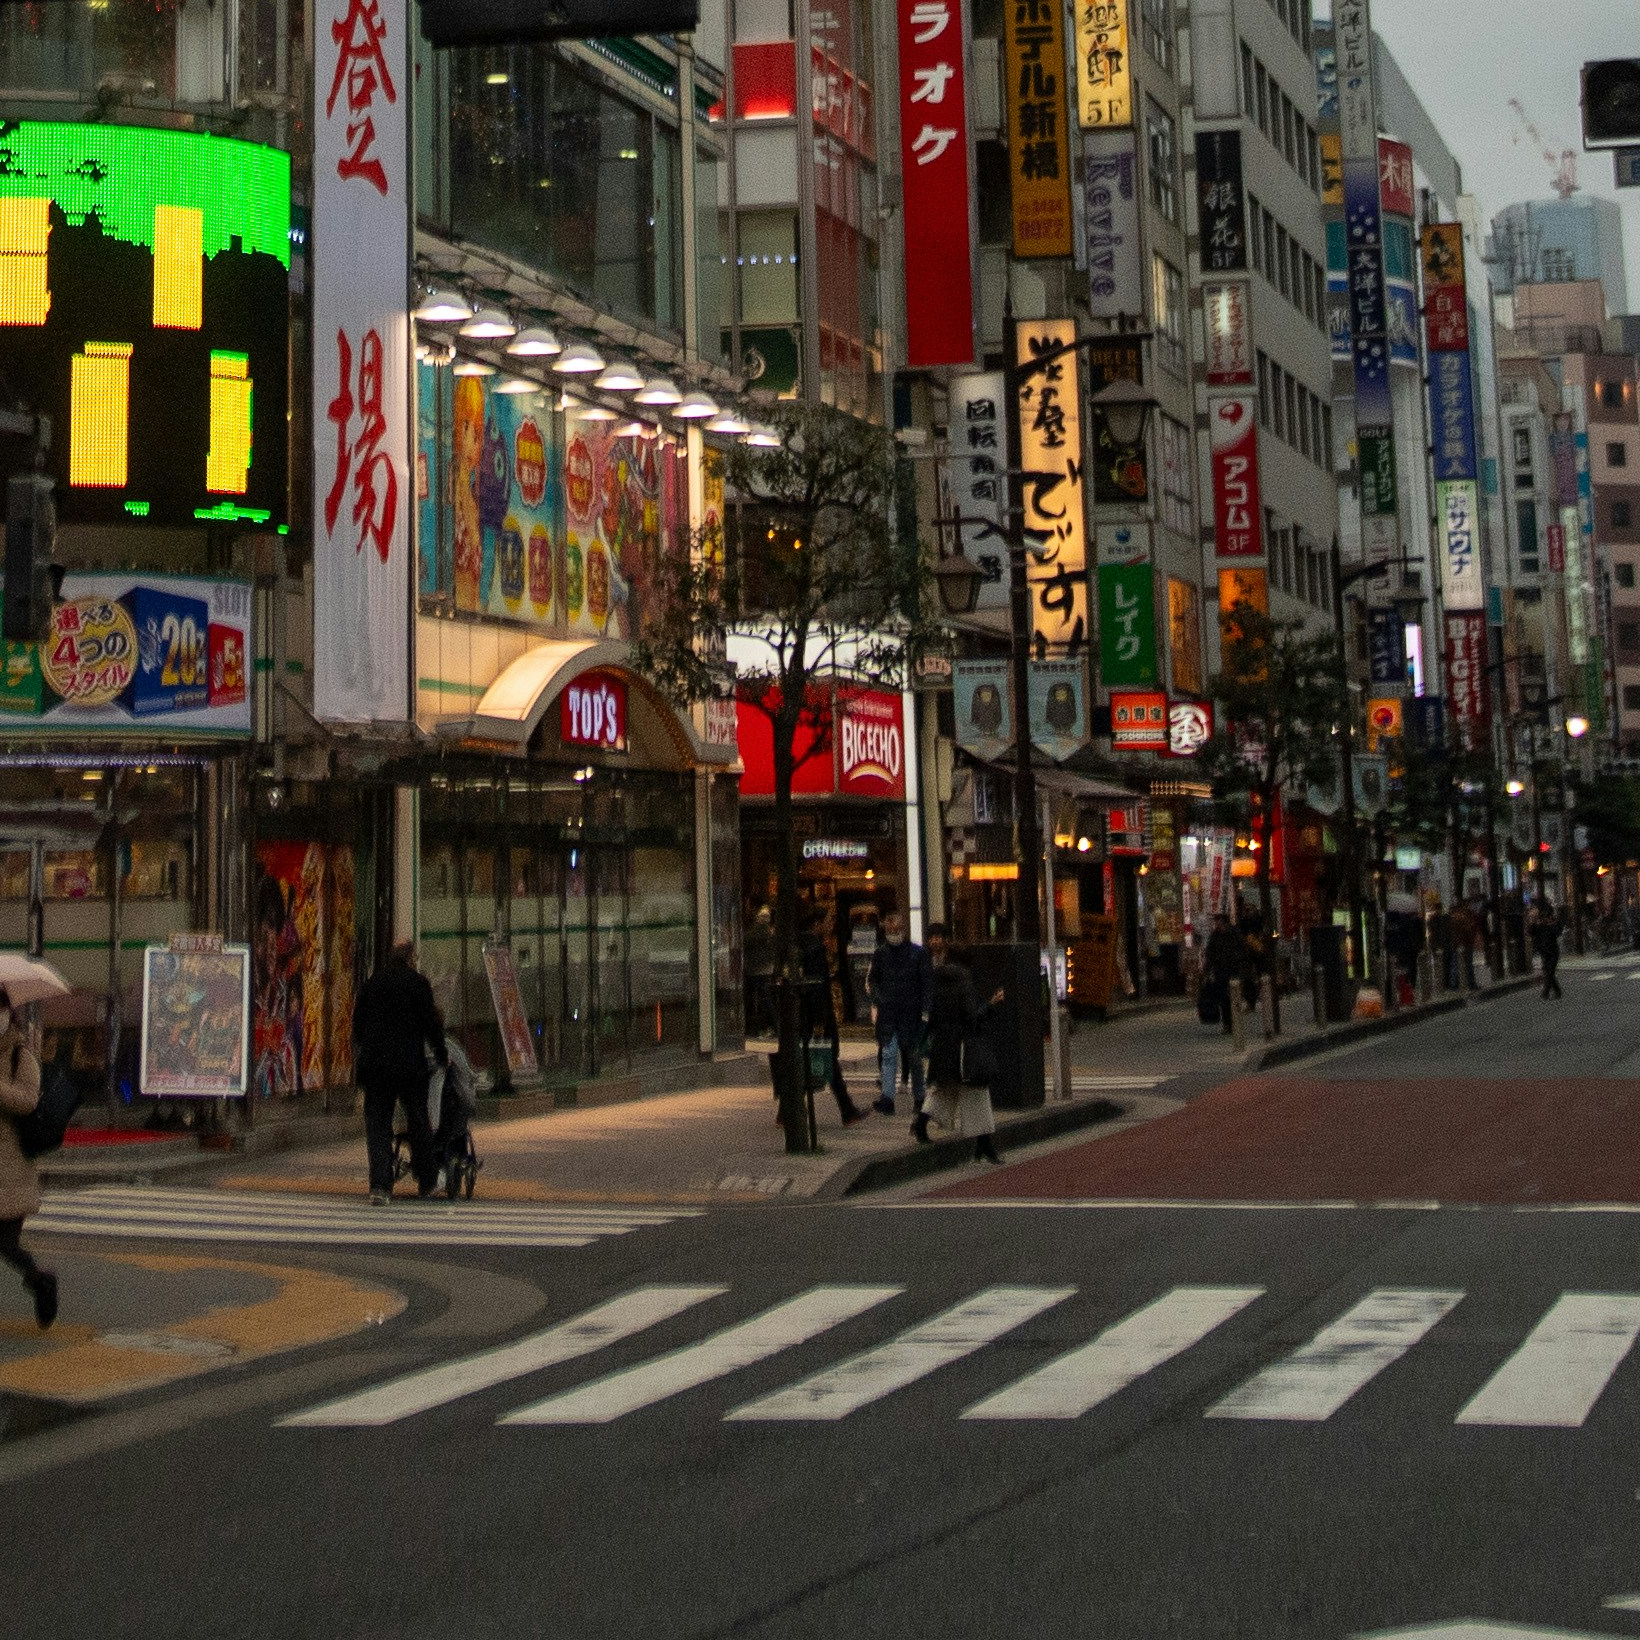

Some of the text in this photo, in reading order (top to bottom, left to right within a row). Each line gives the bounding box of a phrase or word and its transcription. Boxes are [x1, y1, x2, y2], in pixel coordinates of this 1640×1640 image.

[1085, 98, 1123, 125] 5F
[1087, 153, 1124, 298] Revive
[1223, 456, 1251, 531] アコム
[1447, 511, 1472, 576] サウナ
[56, 603, 115, 632] 選べる
[1114, 581, 1142, 660] レイク
[51, 631, 129, 670] 4つの
[62, 669, 130, 697] スタイル
[841, 716, 901, 778] BIG ECHO
